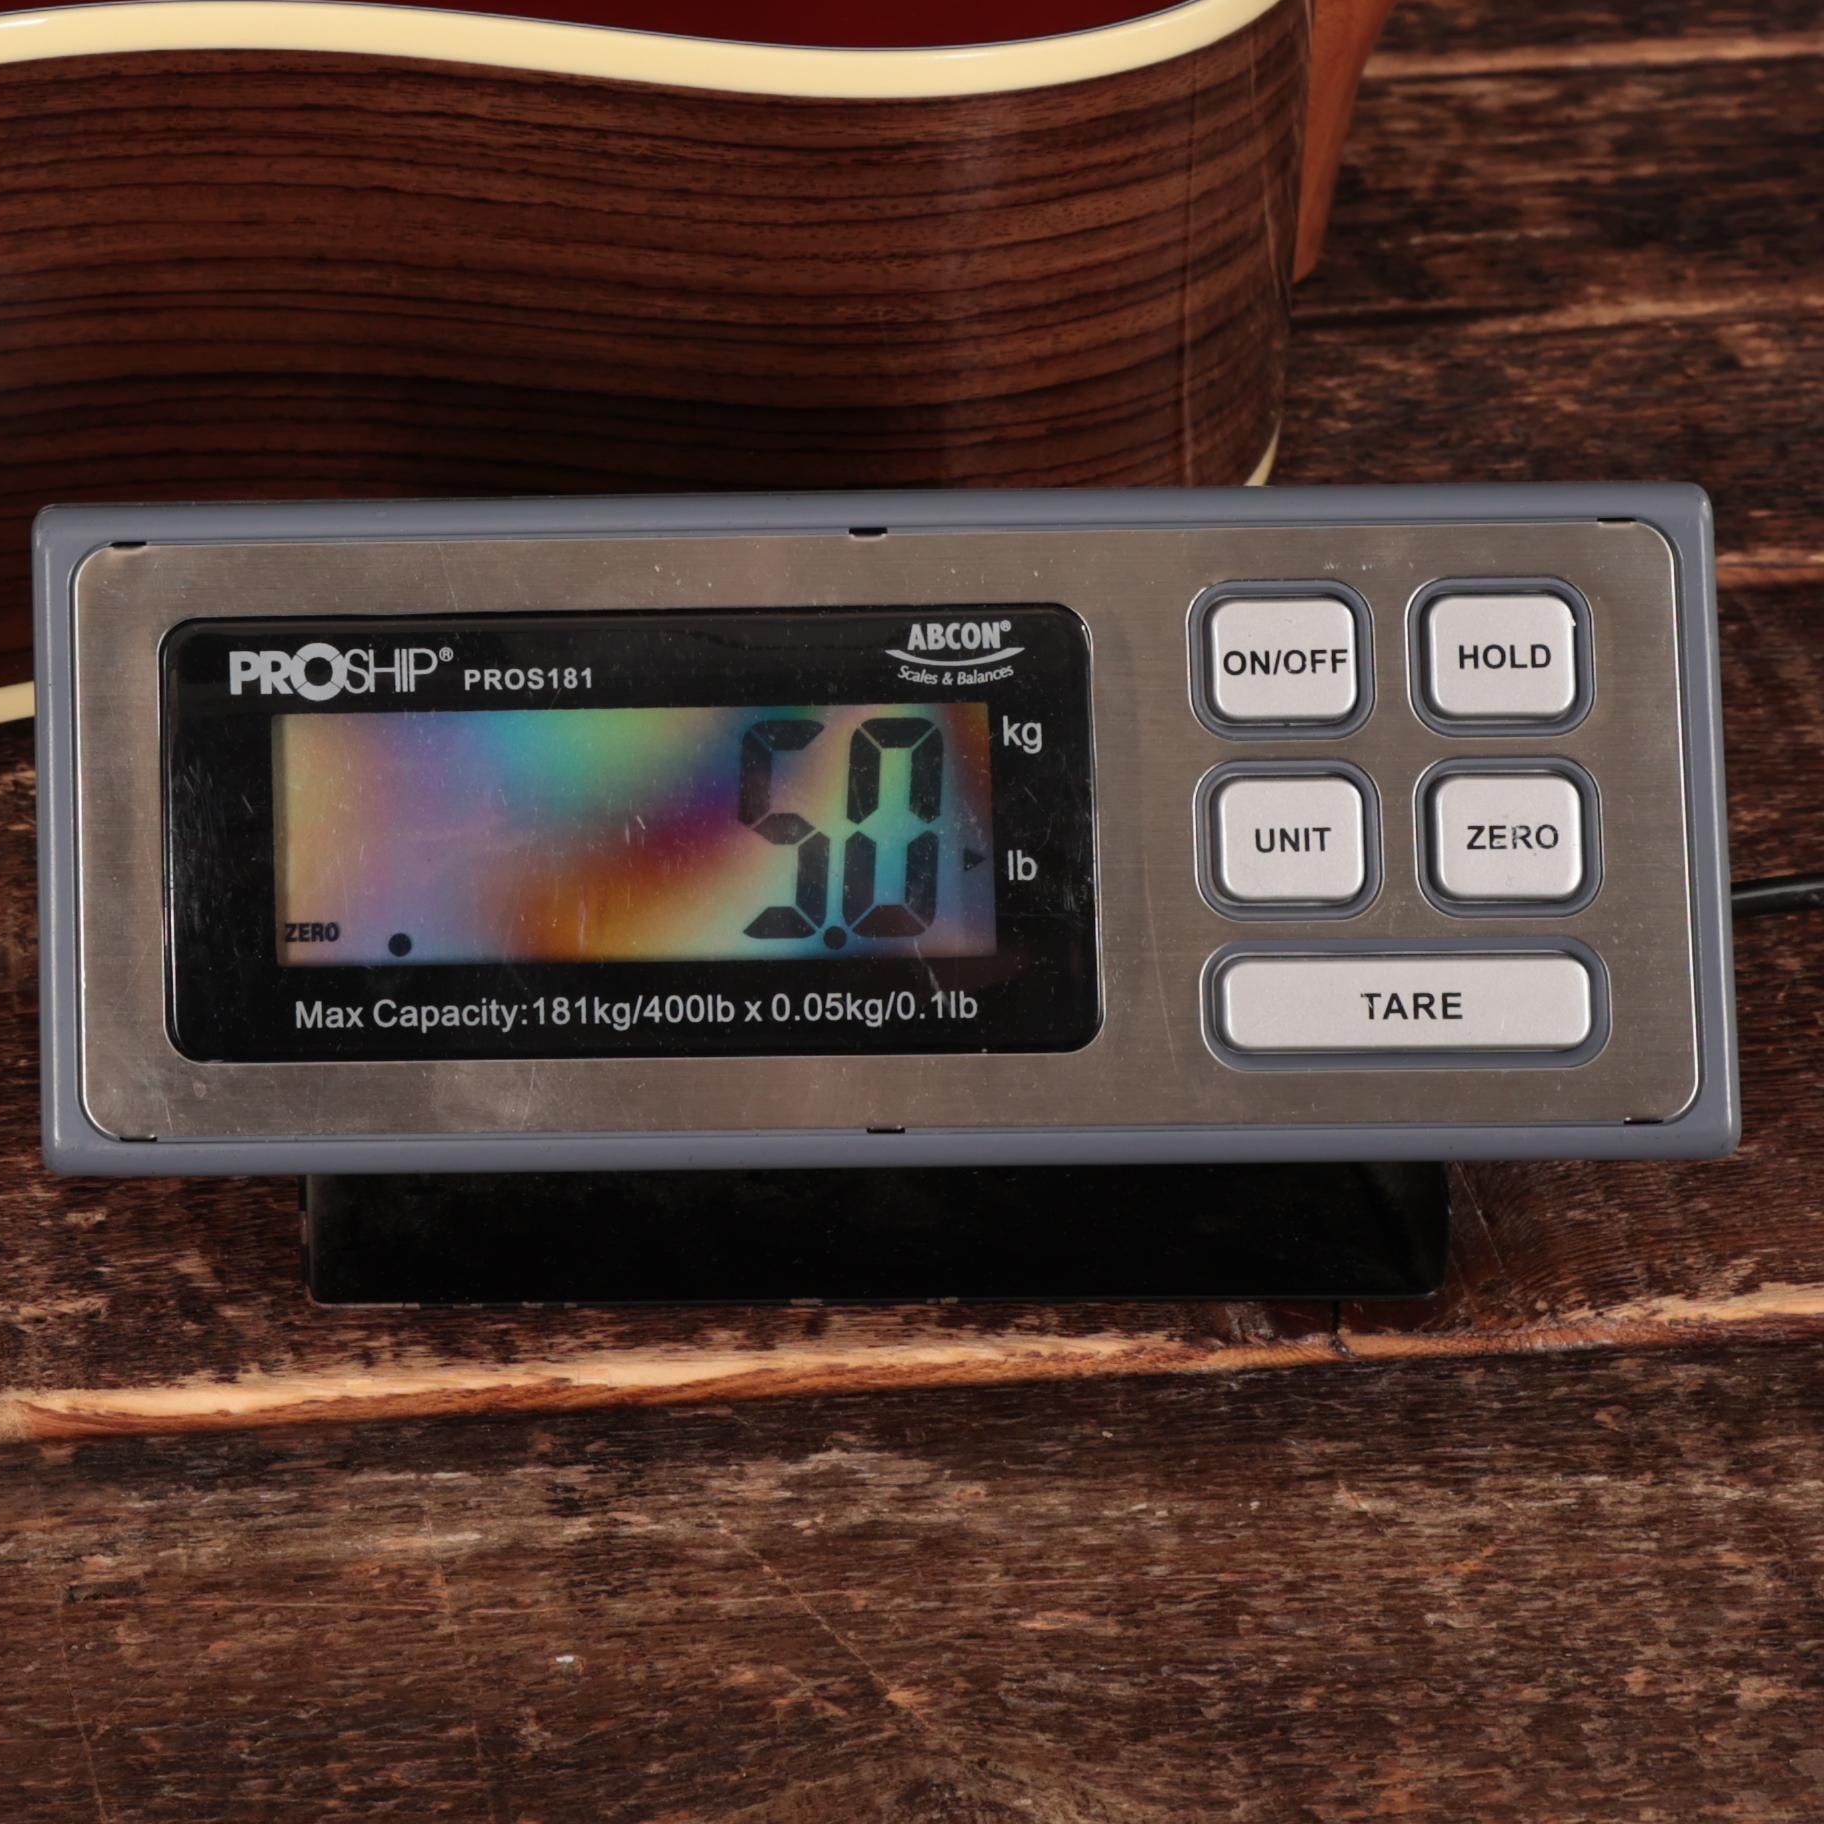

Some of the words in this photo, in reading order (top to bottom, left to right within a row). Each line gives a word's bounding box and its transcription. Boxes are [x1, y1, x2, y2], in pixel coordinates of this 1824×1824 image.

[1222, 649, 1348, 676] ON/OFF
[1458, 644, 1552, 670] HOLD
[464, 668, 593, 691] PROS181
[897, 665, 938, 685] Scales
[942, 671, 953, 686] &
[957, 664, 1014, 686] Balances
[1001, 714, 1044, 755] kg
[739, 716, 945, 944] 5.0
[1255, 826, 1332, 853] UNIT
[1466, 824, 1560, 851] ZERO
[1006, 850, 1038, 882] lb
[283, 921, 340, 944] ZERO
[295, 1000, 364, 1030] Max
[744, 1002, 763, 1022] x
[771, 989, 978, 1027] 0.05kg/0.1lb
[1360, 992, 1463, 1020] TARE
